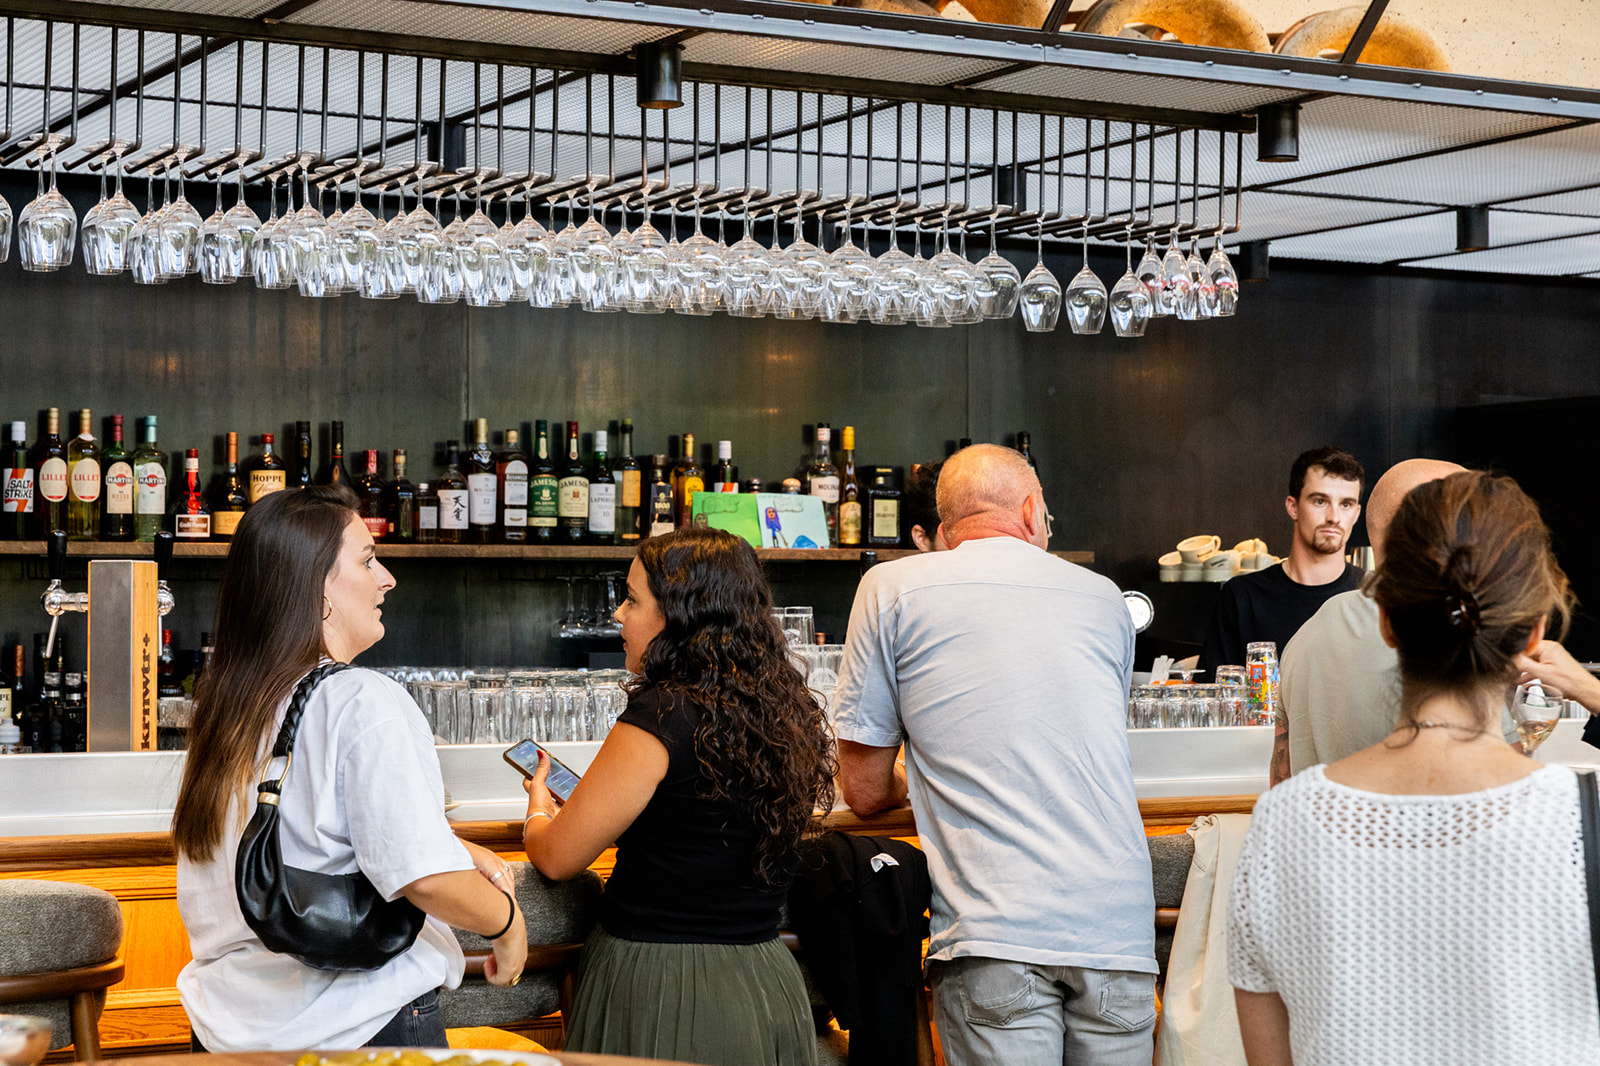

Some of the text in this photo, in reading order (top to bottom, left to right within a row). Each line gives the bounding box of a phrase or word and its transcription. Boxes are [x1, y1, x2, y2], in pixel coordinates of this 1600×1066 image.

[253, 474, 282, 482] HOPPE
[10, 480, 31, 489] SALT
[5, 489, 33, 499] STRIKE
